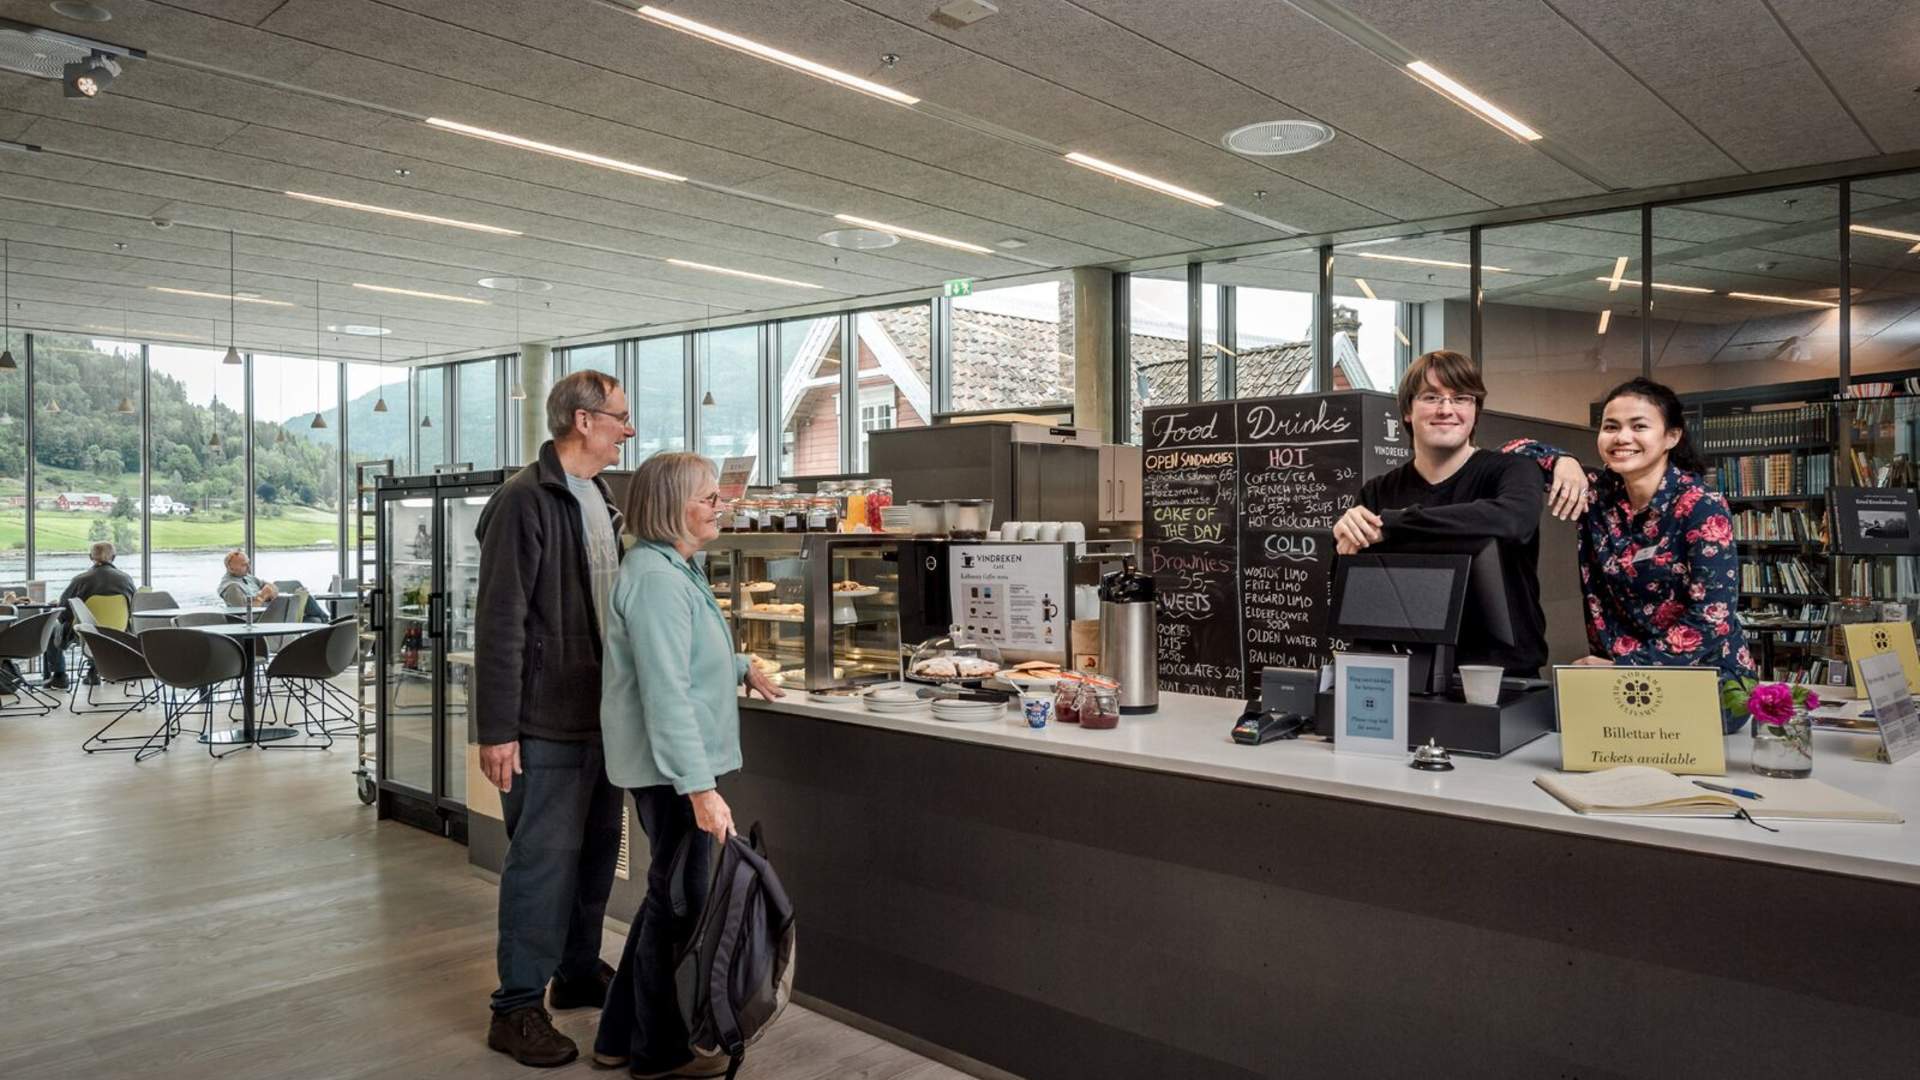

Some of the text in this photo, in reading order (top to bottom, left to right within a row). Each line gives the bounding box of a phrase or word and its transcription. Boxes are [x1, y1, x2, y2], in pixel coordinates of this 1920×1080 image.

[1246, 400, 1352, 440] Drinks
[1152, 412, 1218, 447] Food
[1145, 451, 1234, 470] OPEN SANDWICHES
[1268, 448, 1309, 467] HOT
[1247, 482, 1327, 498] FRENCH PRESS
[1153, 506, 1218, 522] CAKE OF
[1248, 512, 1333, 529] HOT CHOCOLATE
[1161, 523, 1222, 540] THE DAY
[1264, 534, 1316, 555] COLD
[975, 553, 1022, 562] VINDREKEN
[1152, 546, 1230, 573] Brownies
[1284, 567, 1309, 583] LIMO
[1244, 579, 1302, 593] FRITZ LIMO
[1155, 592, 1212, 612] WEETS
[1286, 595, 1313, 609] LIMO
[1245, 606, 1309, 623] ELDERFLOWER
[1157, 622, 1191, 638] OOKIES
[1266, 619, 1291, 631] SODA
[1247, 628, 1281, 644] OLDEN
[1284, 634, 1318, 648] WATER
[1248, 649, 1297, 667] BALHOLM
[1158, 662, 1222, 680] HOCOLATES
[1602, 726, 1681, 740] Billettar her
[1591, 750, 1697, 765] Tickets available
